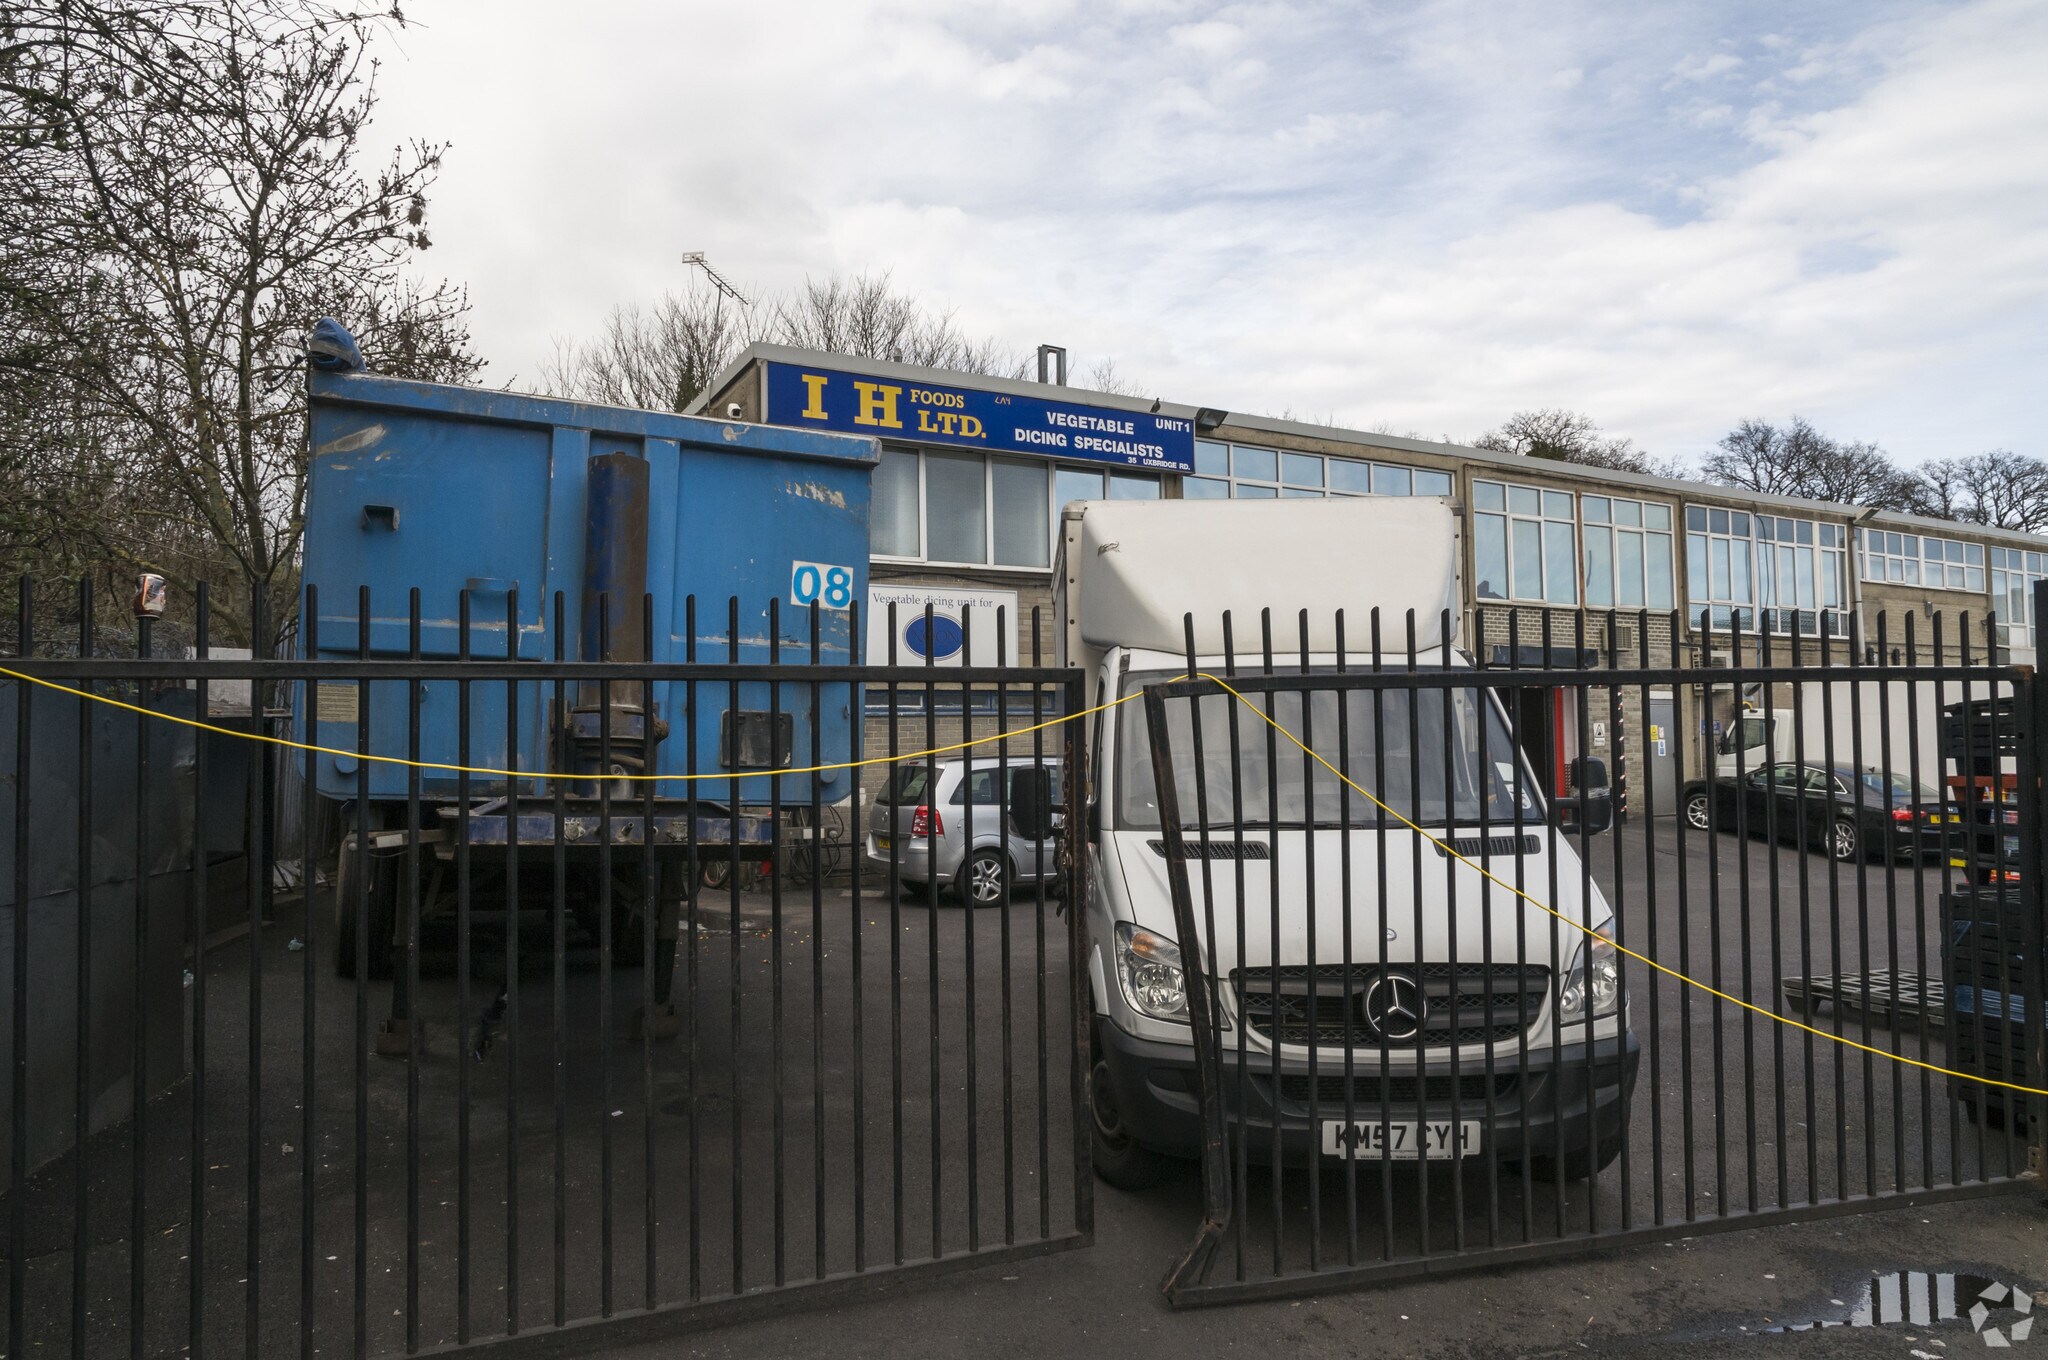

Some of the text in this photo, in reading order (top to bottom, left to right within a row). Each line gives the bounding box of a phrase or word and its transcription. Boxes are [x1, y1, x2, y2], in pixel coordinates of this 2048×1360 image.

[802, 374, 902, 428] I H
[910, 389, 964, 408] FOODS
[918, 410, 986, 438] LTD.
[1047, 412, 1134, 435] VEGETABLE
[1156, 419, 1190, 432] UNIT 1
[1015, 428, 1163, 458] DICING SPECIALISTS
[1143, 458, 1176, 469] UXBRIDGE
[793, 565, 851, 608] 08
[873, 593, 993, 608] Vegetable dicing unit for
